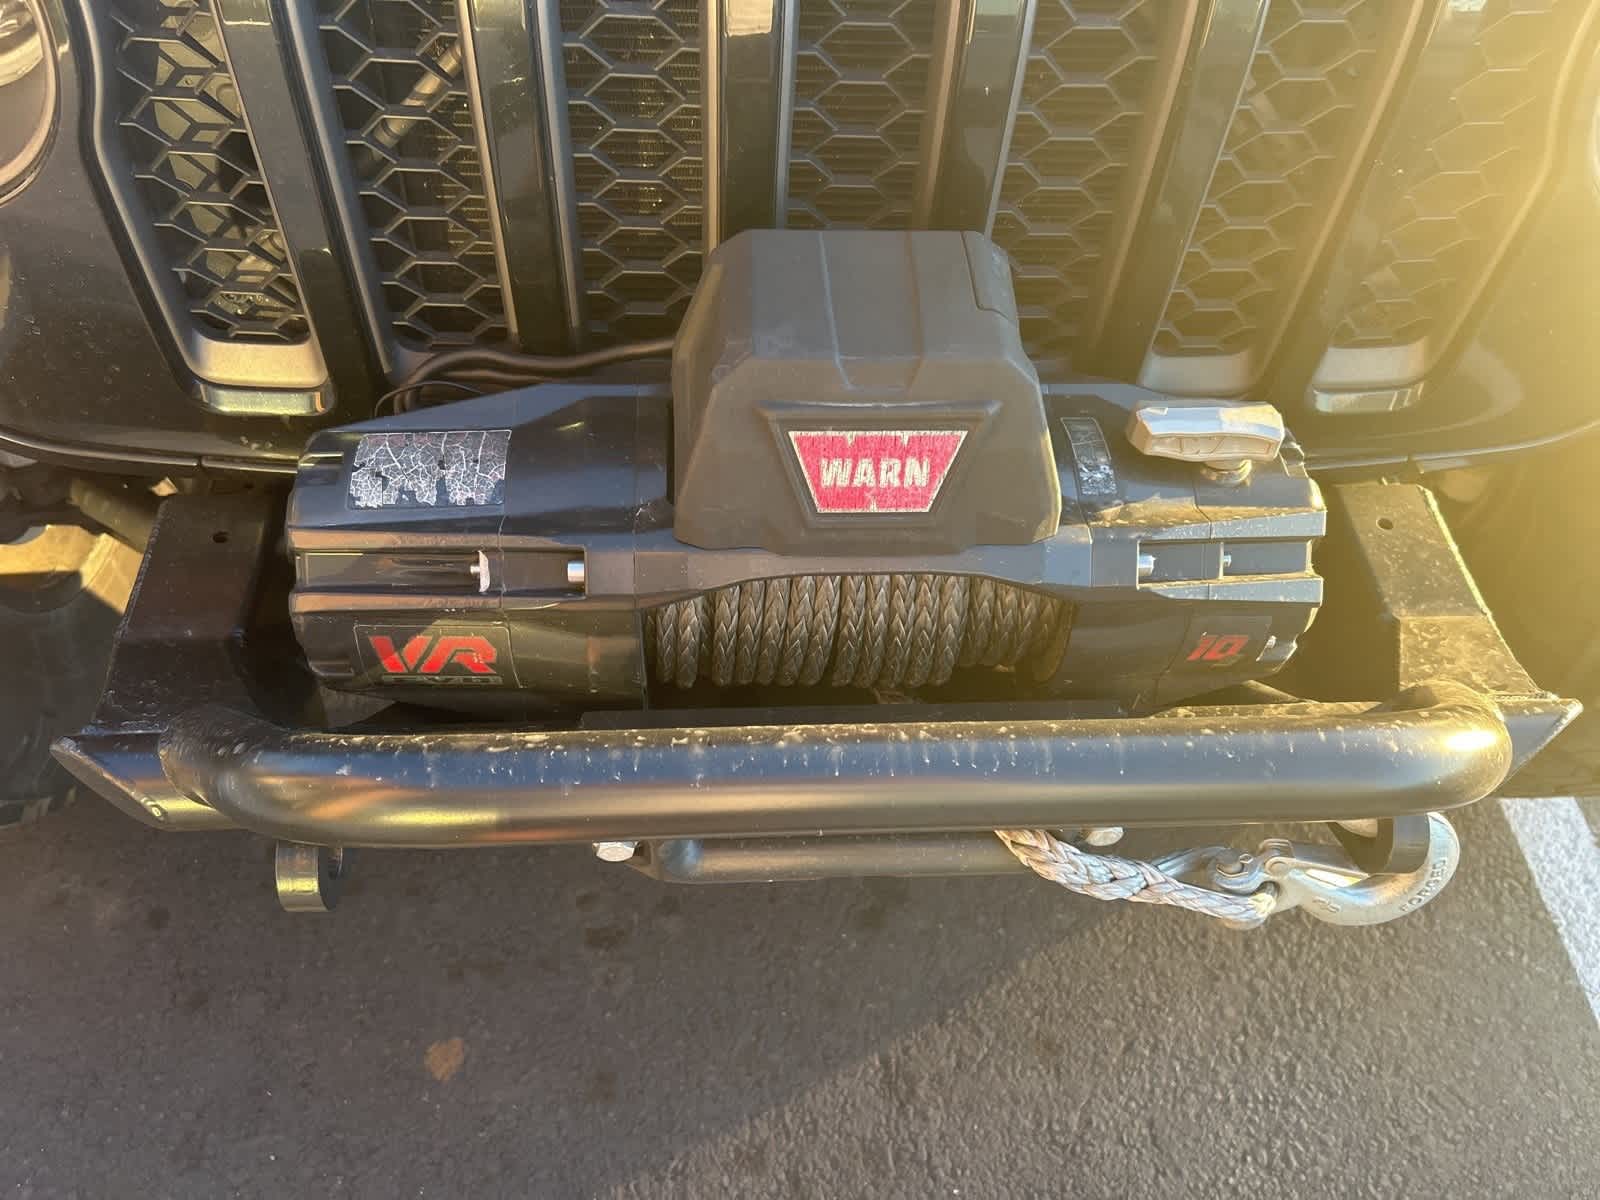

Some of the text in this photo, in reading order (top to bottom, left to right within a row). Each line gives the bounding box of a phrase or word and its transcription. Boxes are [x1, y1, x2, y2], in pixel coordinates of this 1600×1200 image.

[819, 457, 931, 488] WARN
[368, 635, 497, 674] VR
[1186, 634, 1249, 662] 10
